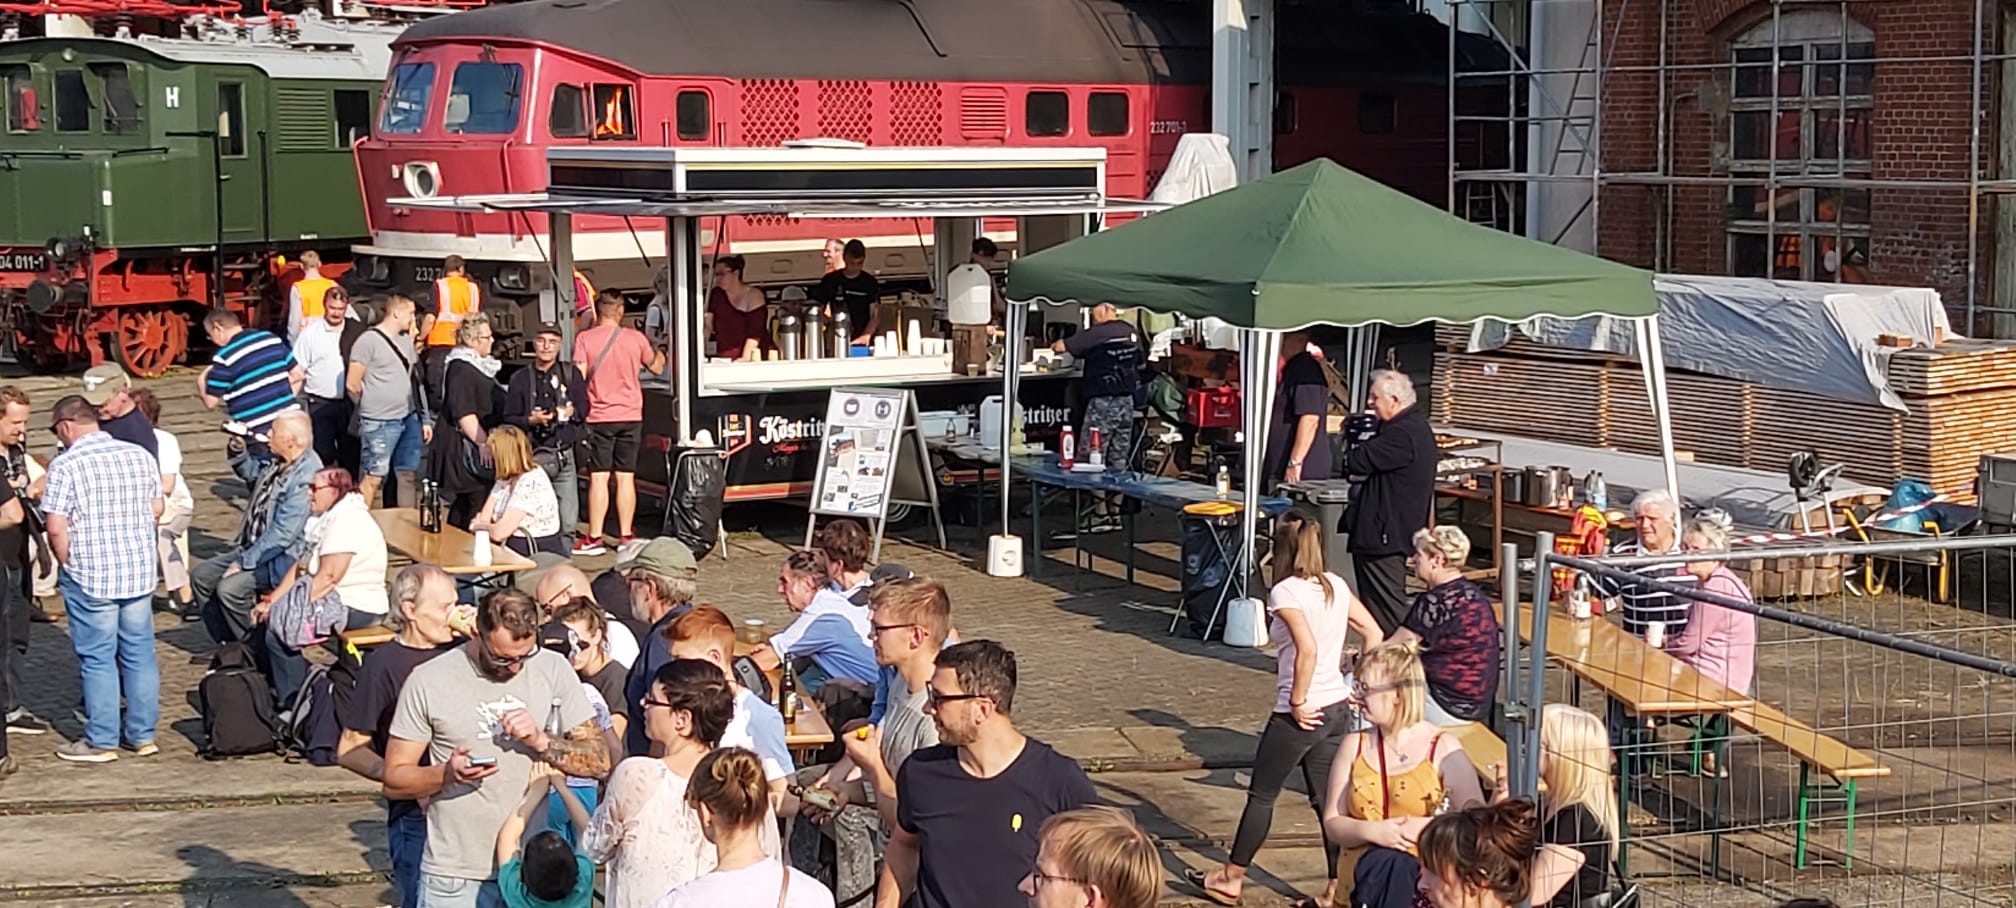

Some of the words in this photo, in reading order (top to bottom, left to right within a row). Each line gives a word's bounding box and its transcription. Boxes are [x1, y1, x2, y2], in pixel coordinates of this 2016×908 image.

[166, 86, 179, 108] H
[15, 255, 44, 270] 011-1
[415, 266, 434, 282] 232
[759, 415, 827, 445] Köstrit
